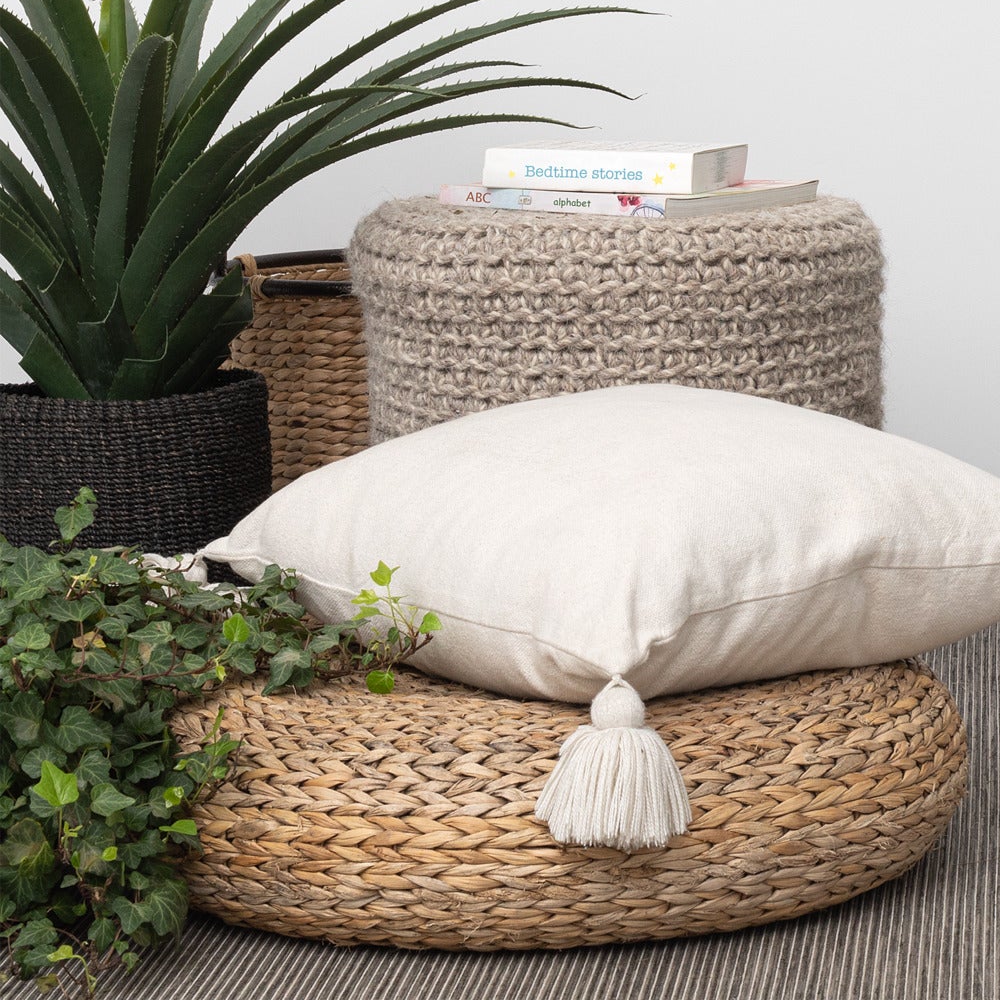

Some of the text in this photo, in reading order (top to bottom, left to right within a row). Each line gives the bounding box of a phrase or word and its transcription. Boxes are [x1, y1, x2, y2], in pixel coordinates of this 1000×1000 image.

[524, 165, 643, 181] Bedtime stories
[465, 191, 492, 204] ABC
[553, 197, 591, 208] alphabet
